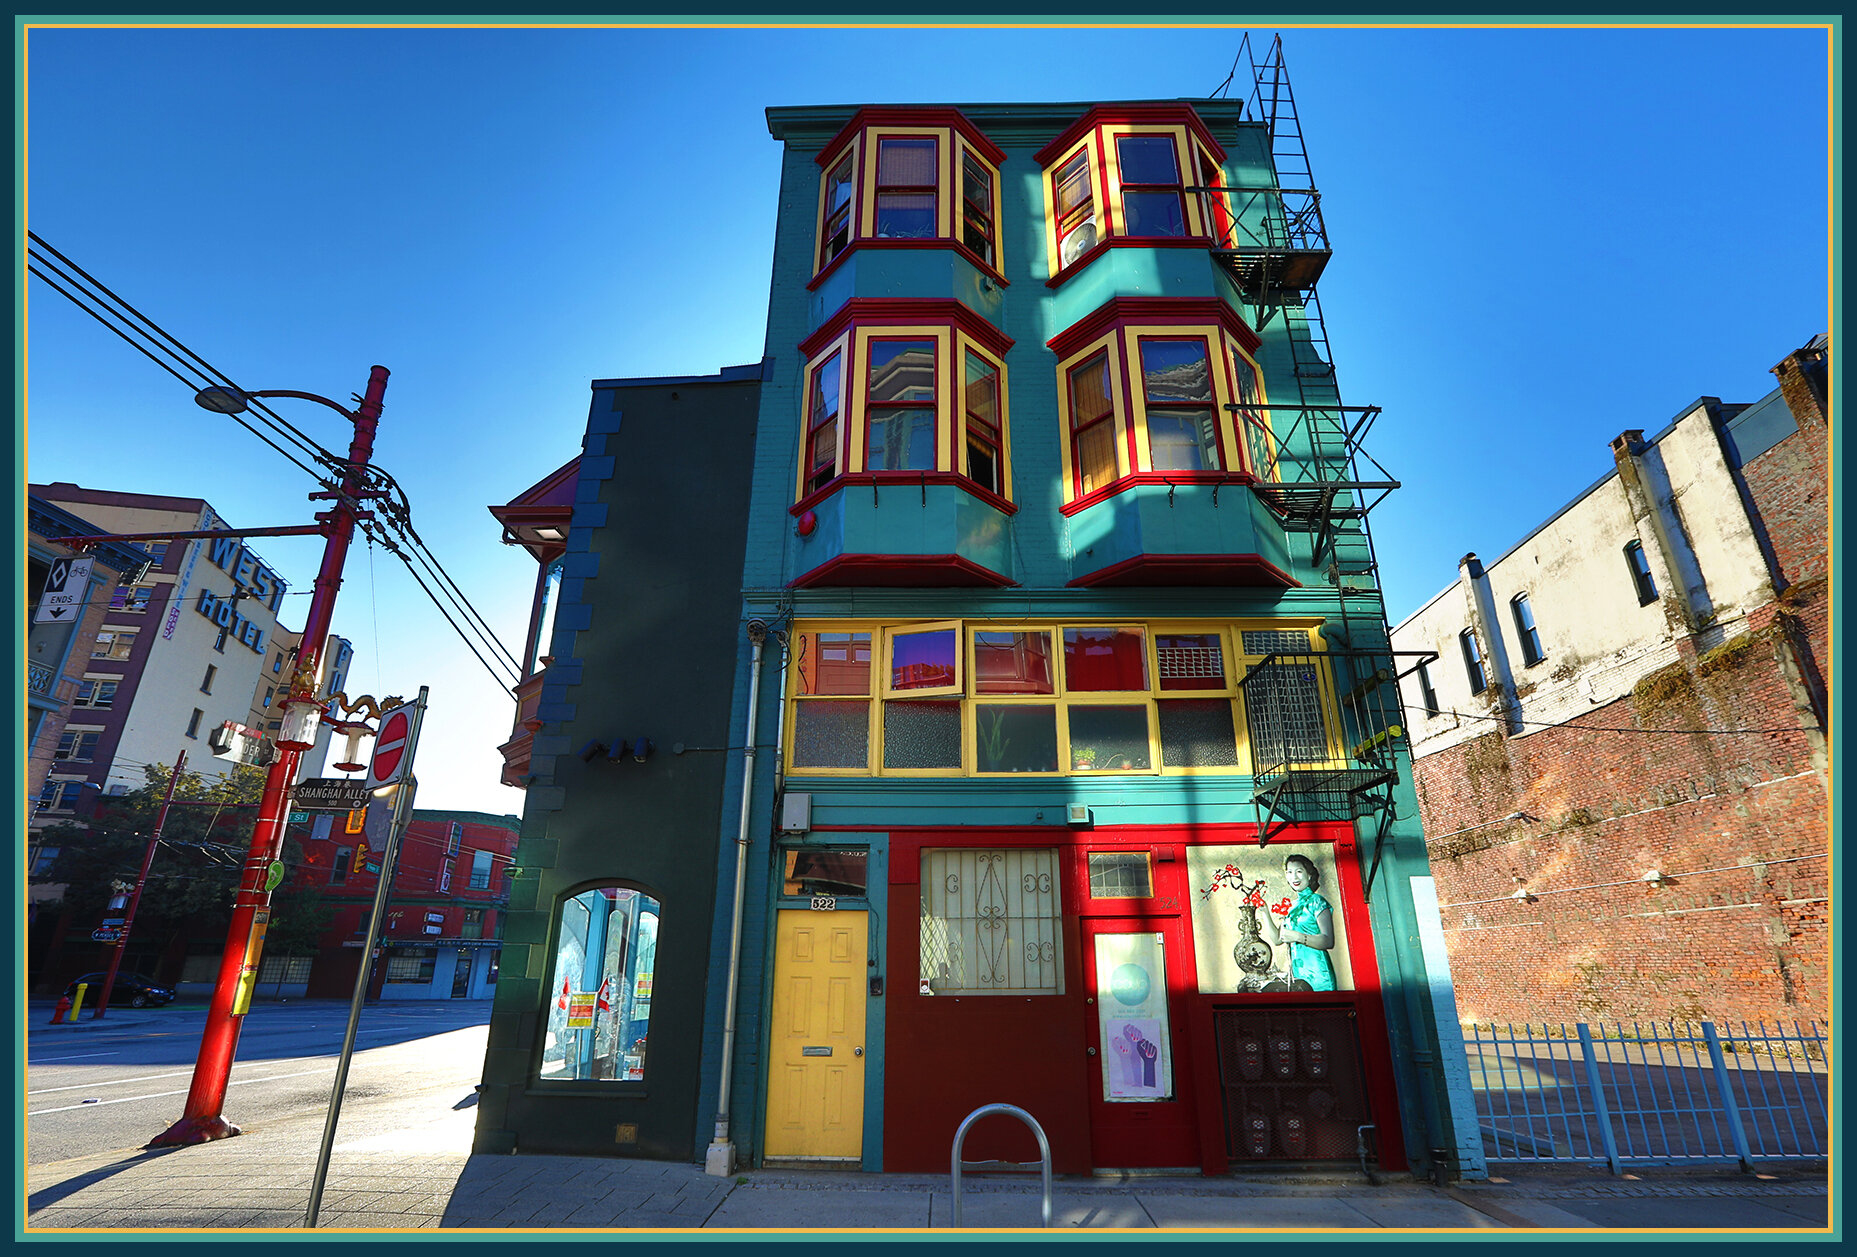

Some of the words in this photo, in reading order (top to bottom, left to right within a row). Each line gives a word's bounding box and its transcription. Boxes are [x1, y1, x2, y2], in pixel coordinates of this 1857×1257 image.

[208, 536, 287, 612] WEST
[50, 595, 73, 604] ENDS
[196, 588, 266, 655] HOTEL
[298, 787, 342, 799] SHANGHAI
[294, 813, 305, 821] St
[812, 899, 834, 909] 522
[1160, 896, 1179, 910] 524
